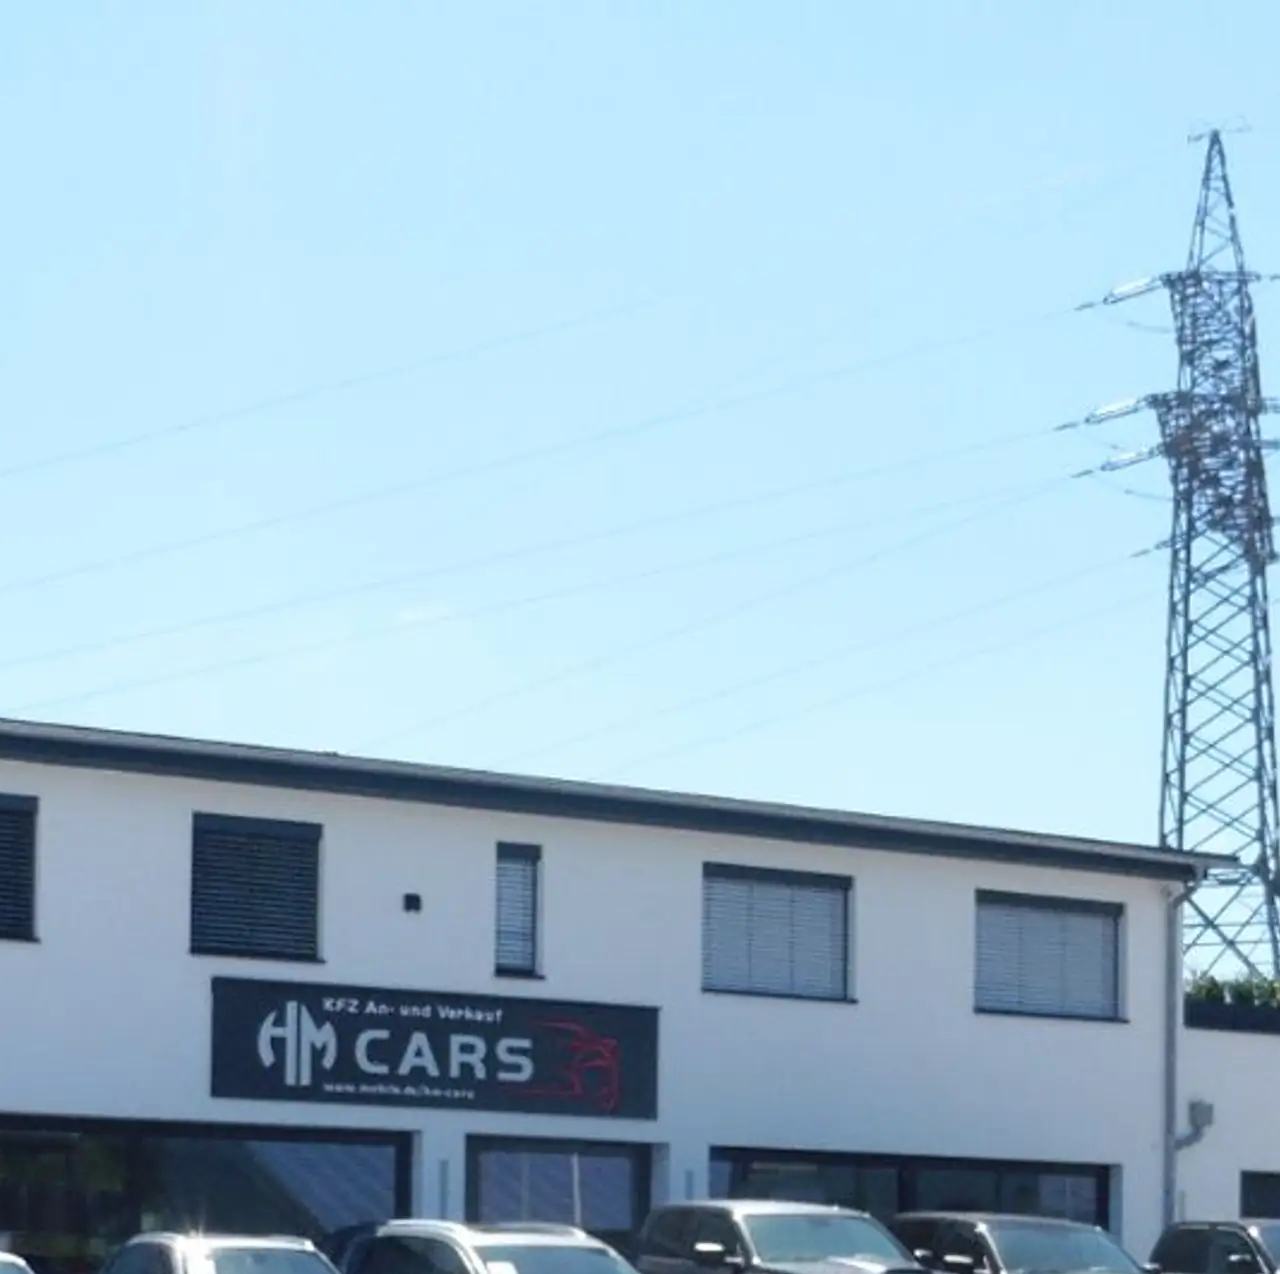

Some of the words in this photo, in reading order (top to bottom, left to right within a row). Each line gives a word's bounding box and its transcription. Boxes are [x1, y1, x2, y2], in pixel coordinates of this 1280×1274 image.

[322, 998, 360, 1013] KFZ
[365, 1000, 395, 1015] An-
[399, 1004, 432, 1018] und
[436, 1004, 503, 1023] Verkauf
[354, 1029, 534, 1083] CARS
